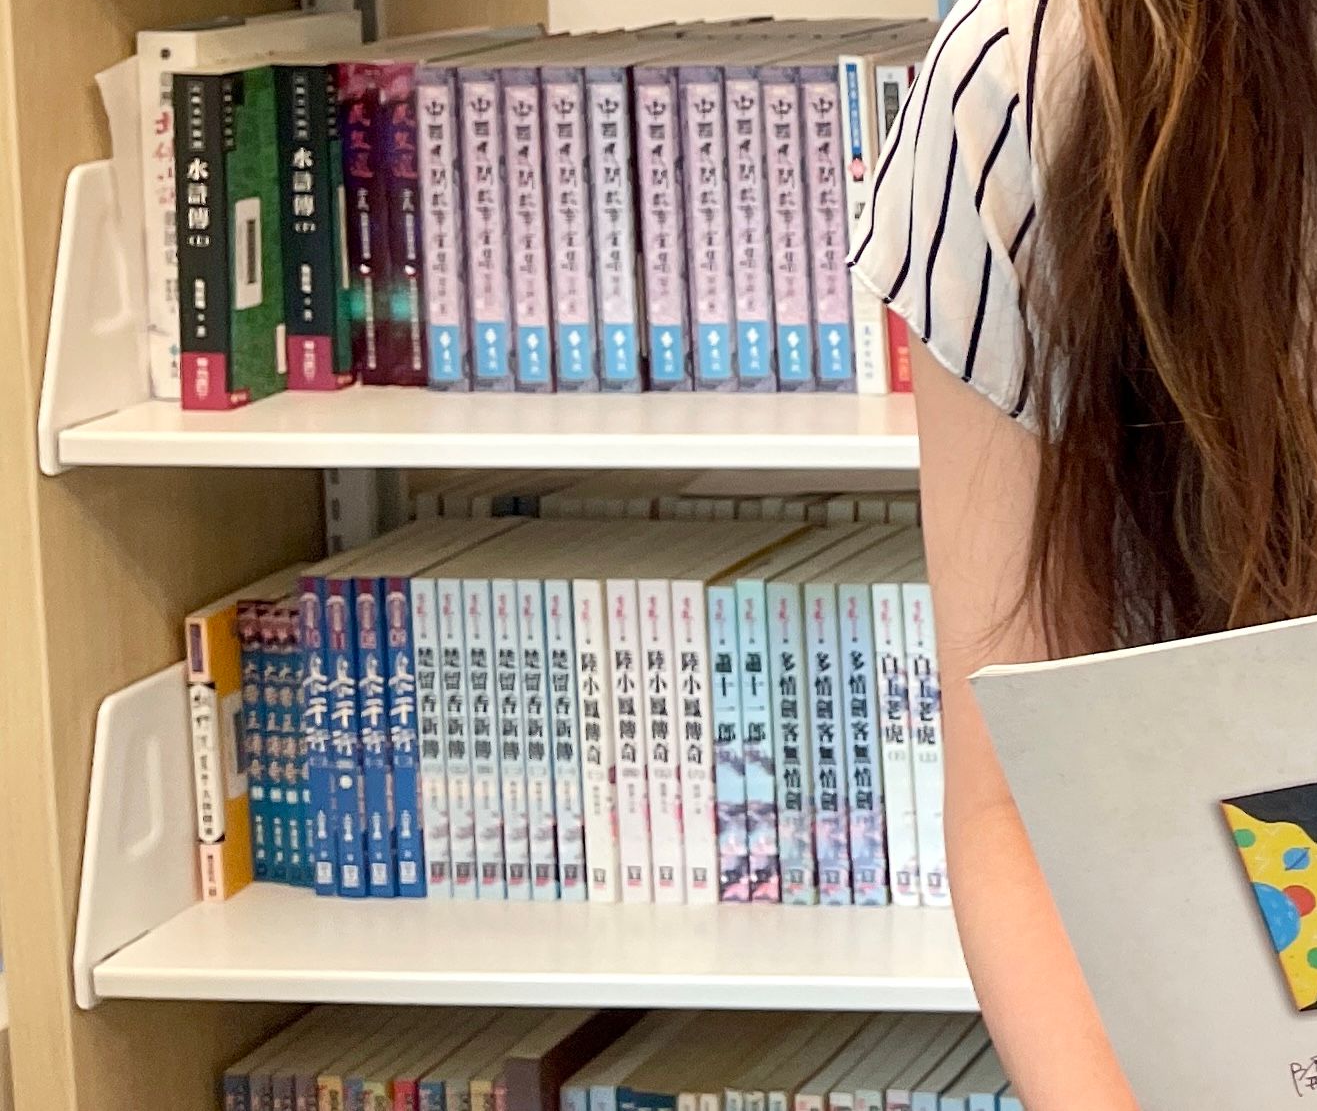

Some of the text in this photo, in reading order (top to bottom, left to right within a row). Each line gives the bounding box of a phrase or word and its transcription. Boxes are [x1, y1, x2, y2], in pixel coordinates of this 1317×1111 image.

[580, 652, 602, 765] 陸小鳳傳奇
[615, 650, 637, 764] 陸小鳳傳奇
[647, 650, 670, 764] 陸小鳳傳奇
[681, 650, 703, 765] 陸小鳳傳奇
